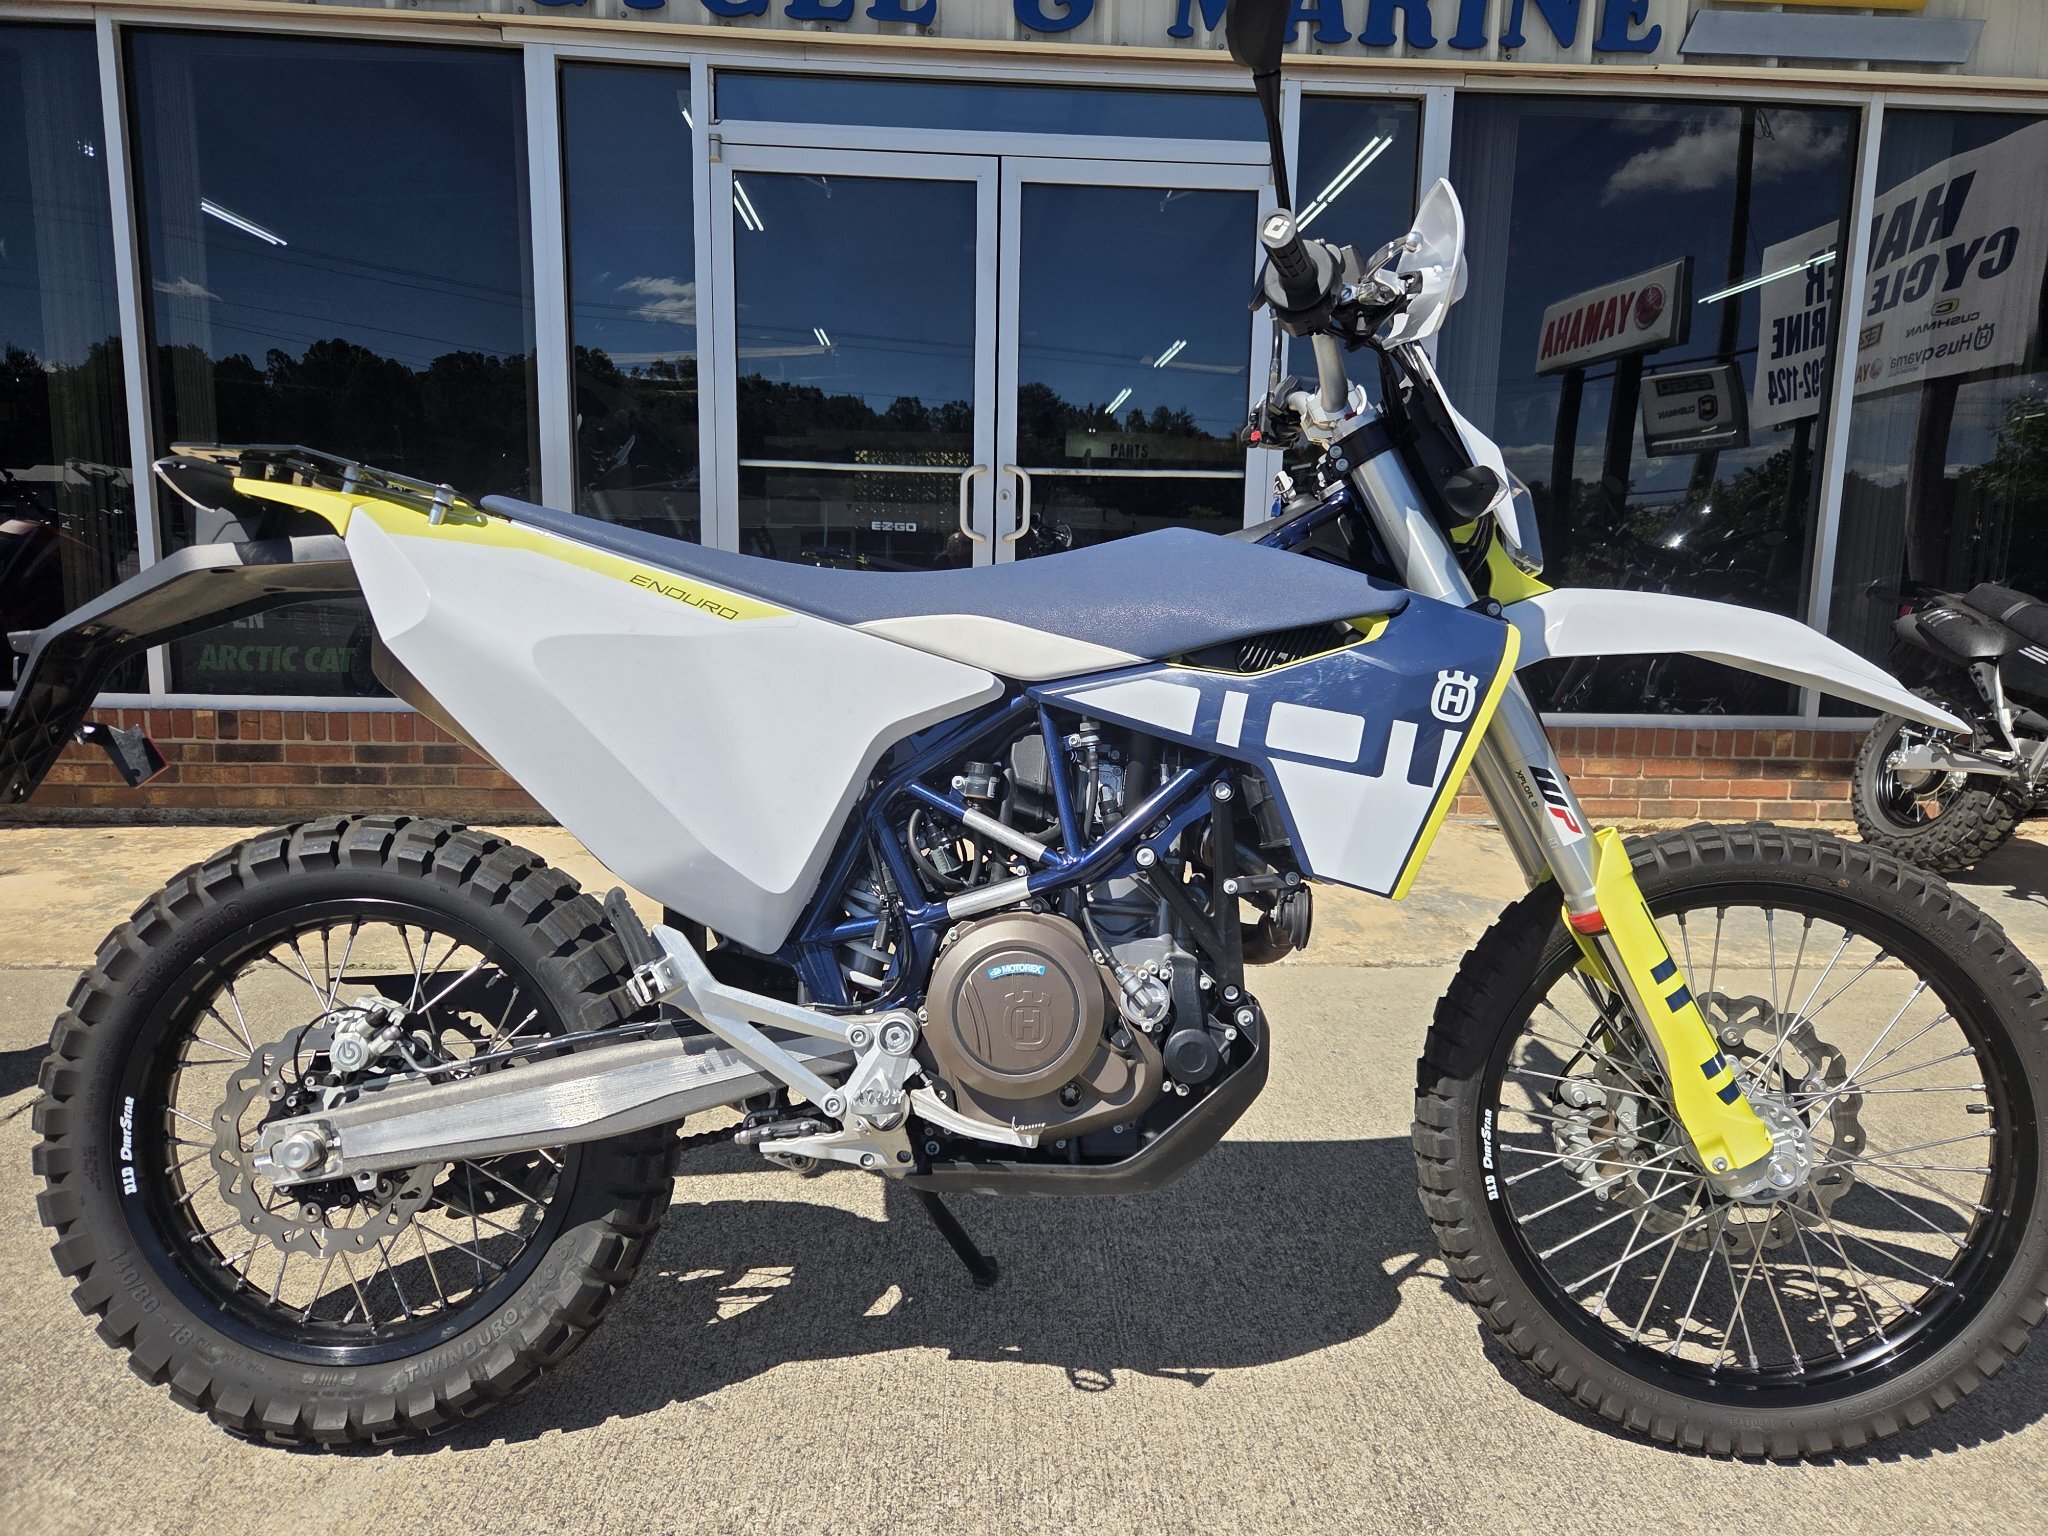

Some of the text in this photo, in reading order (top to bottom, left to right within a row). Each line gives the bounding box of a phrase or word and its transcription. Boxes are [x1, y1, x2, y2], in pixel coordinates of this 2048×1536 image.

[1110, 442, 1149, 459] PARTS
[629, 574, 740, 620] ENDURO
[199, 644, 357, 673] ARCTIC CAT
[1514, 769, 1534, 799] XPLOR
[1001, 963, 1042, 974] MOTOREX
[403, 1307, 519, 1383] TWINDURO
